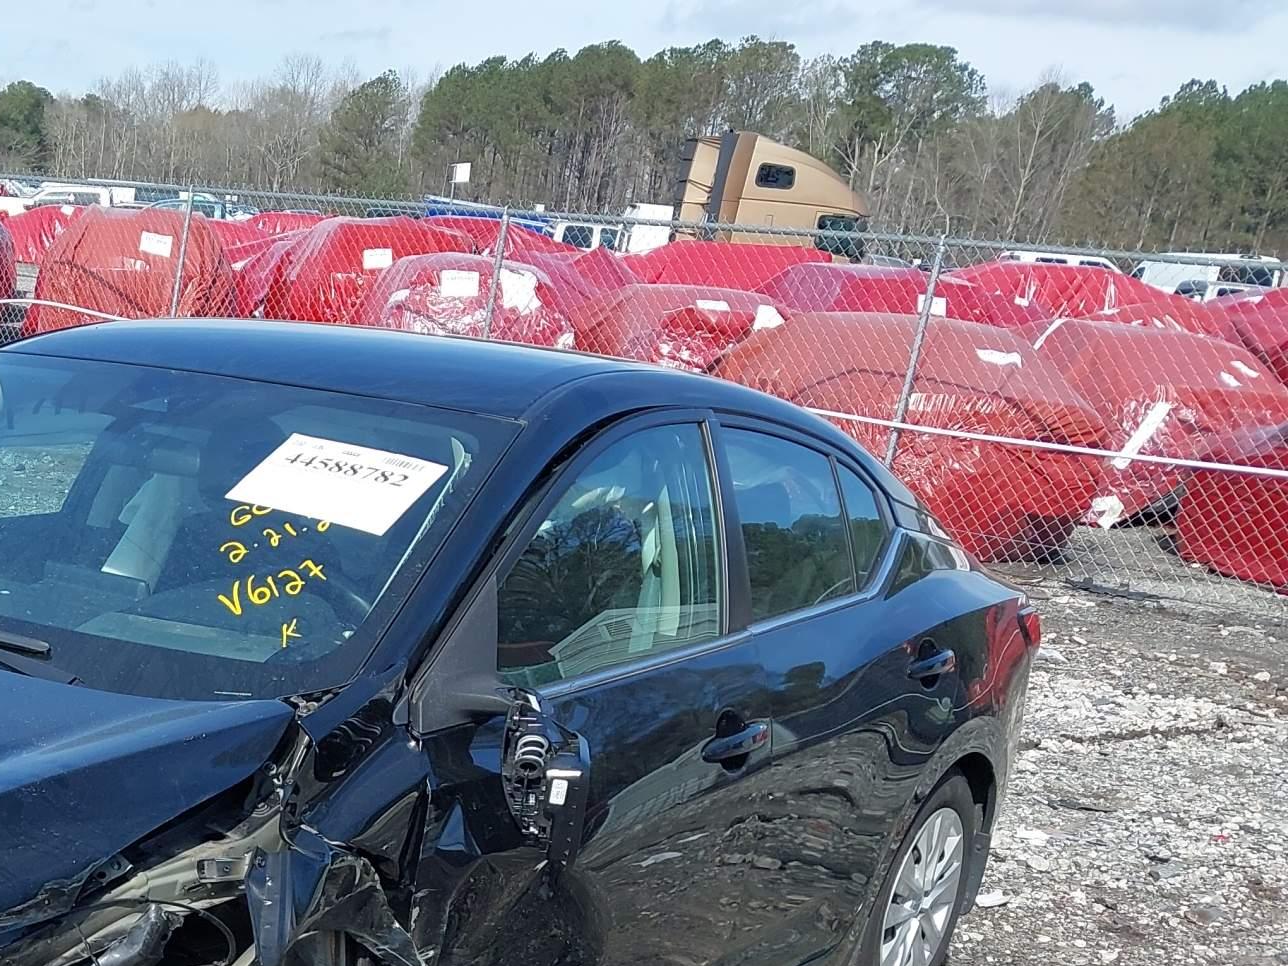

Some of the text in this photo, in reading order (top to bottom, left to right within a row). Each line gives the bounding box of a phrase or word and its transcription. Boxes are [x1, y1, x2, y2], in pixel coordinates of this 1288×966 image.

[285, 452, 409, 487] 44588782
[218, 559, 327, 616] V6127
[281, 618, 303, 648] K
